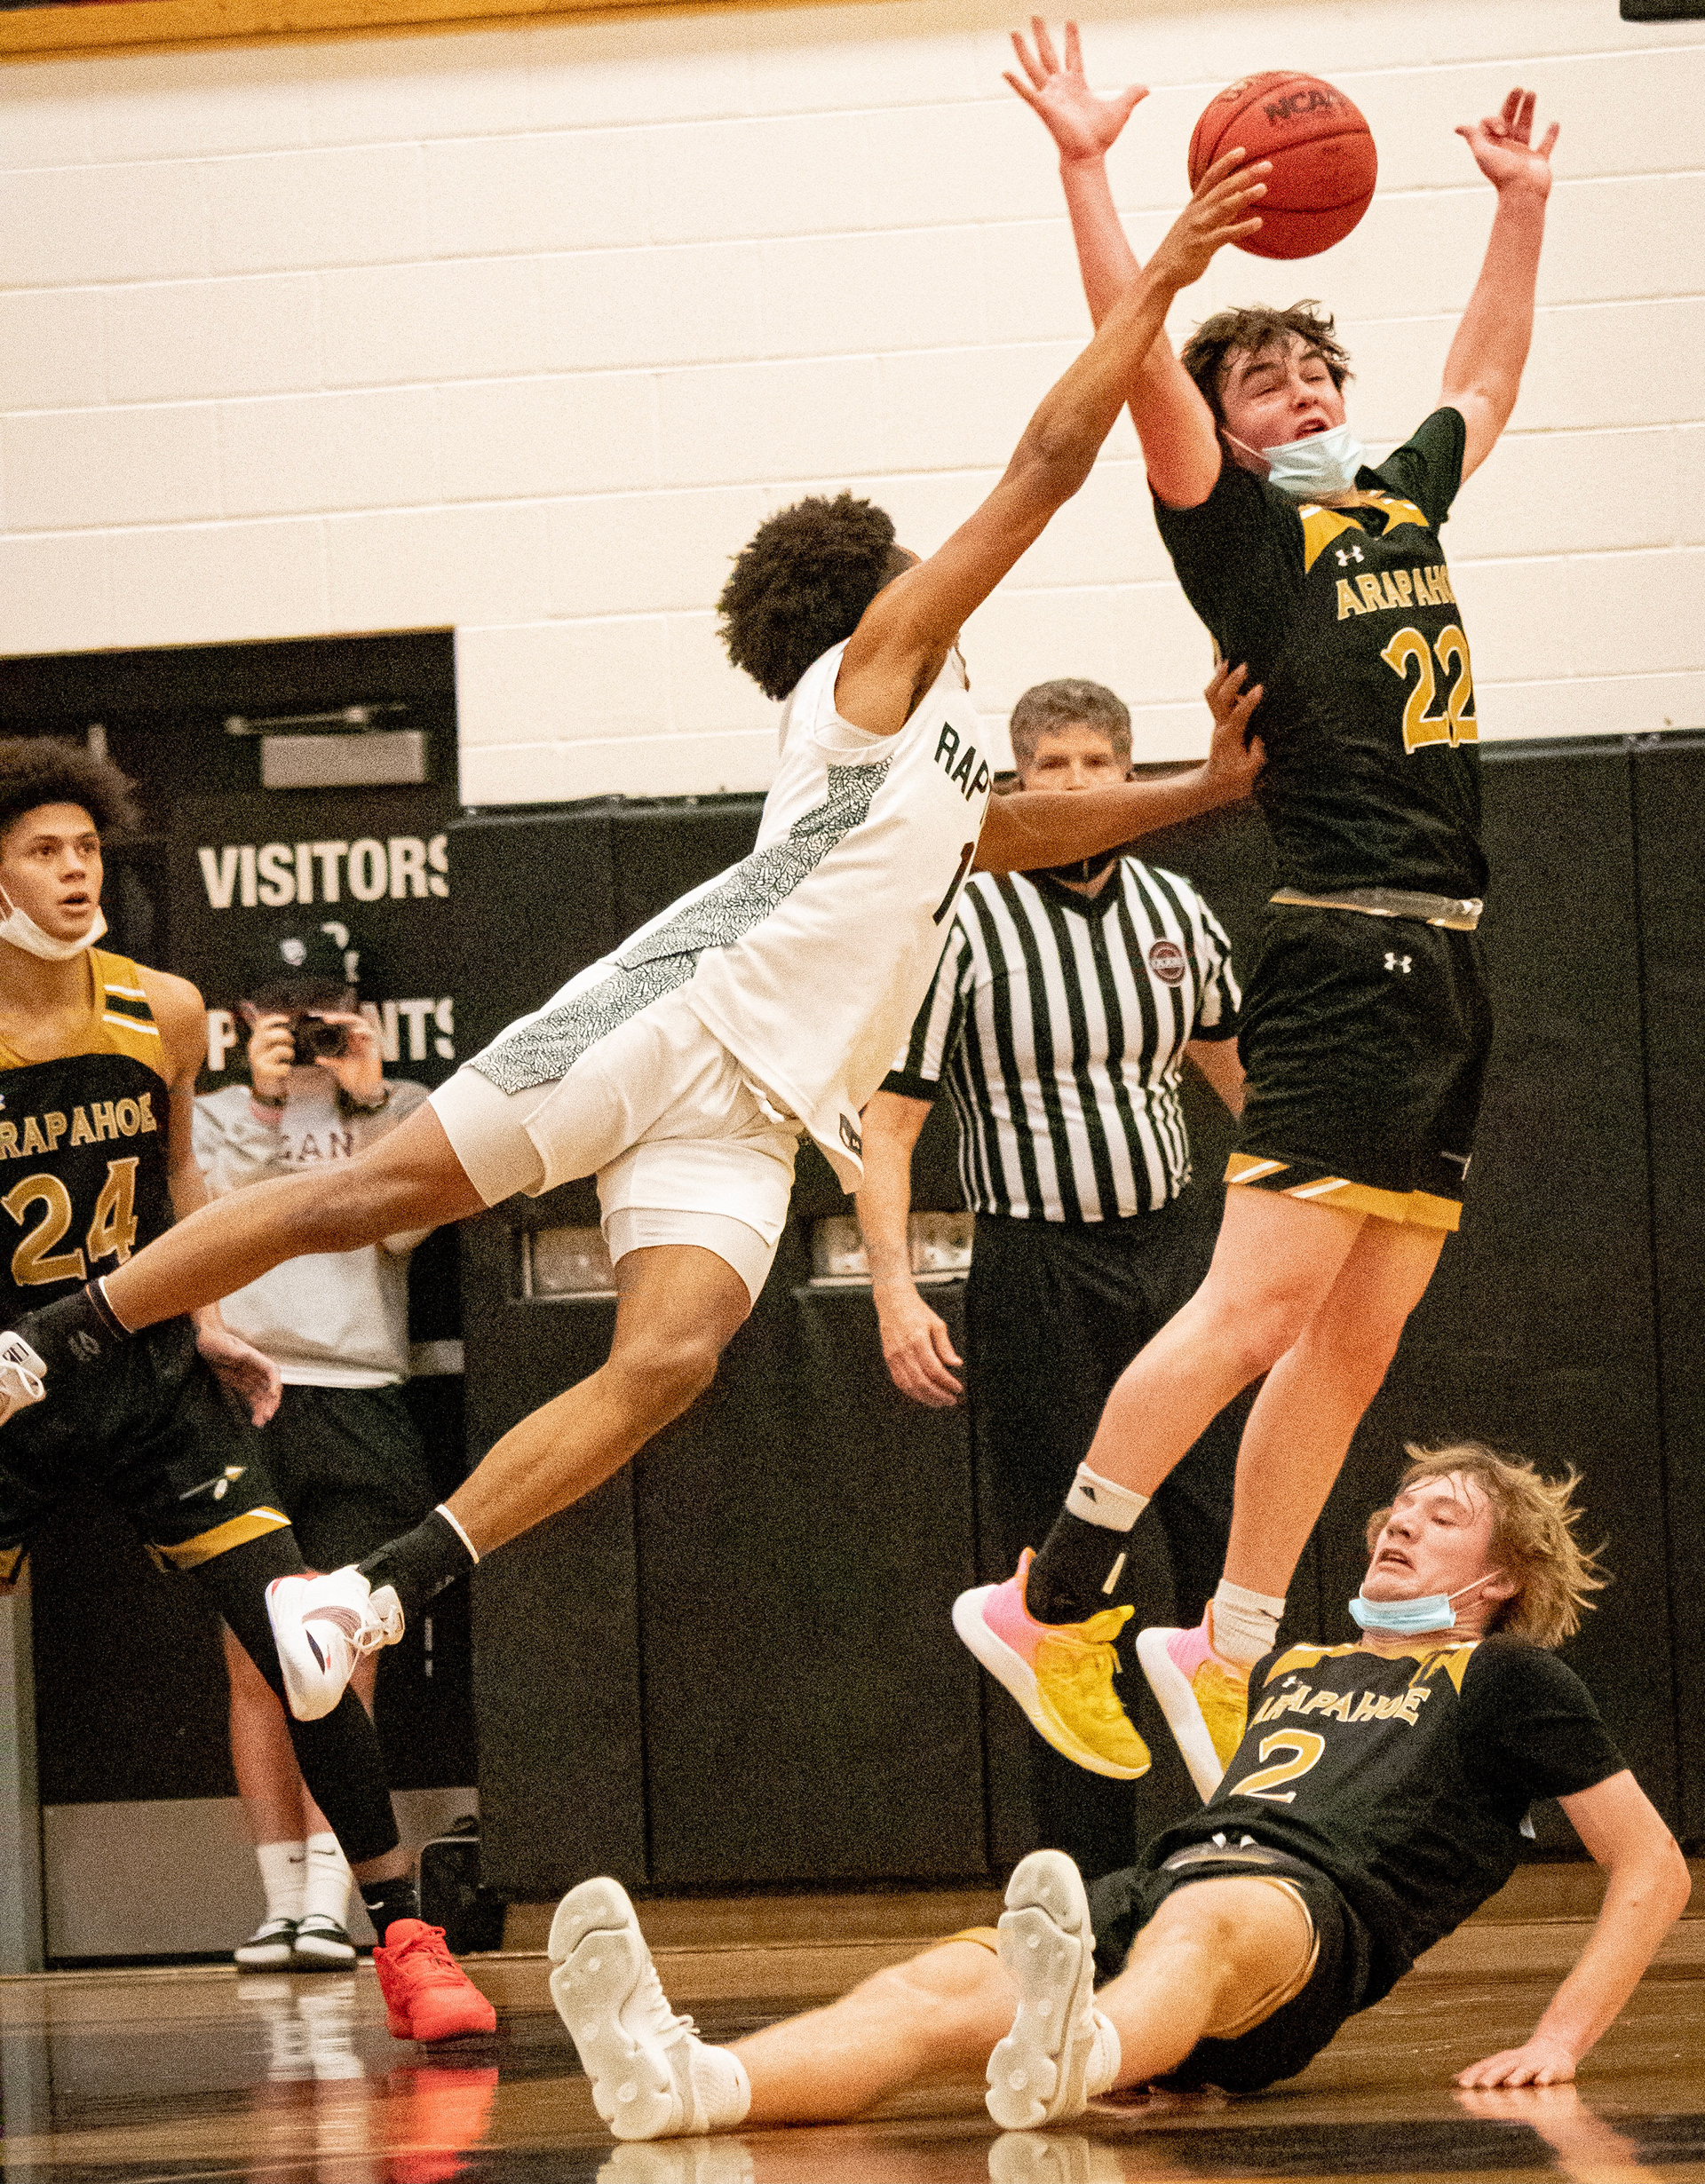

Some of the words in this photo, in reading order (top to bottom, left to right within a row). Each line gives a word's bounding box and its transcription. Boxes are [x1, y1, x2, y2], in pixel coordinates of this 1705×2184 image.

[1380, 623, 1480, 755] 22
[198, 835, 450, 909] VISITORS
[206, 995, 456, 1072] PNTS
[1, 1156, 140, 1287] 24
[1228, 1728, 1326, 1804] 2
